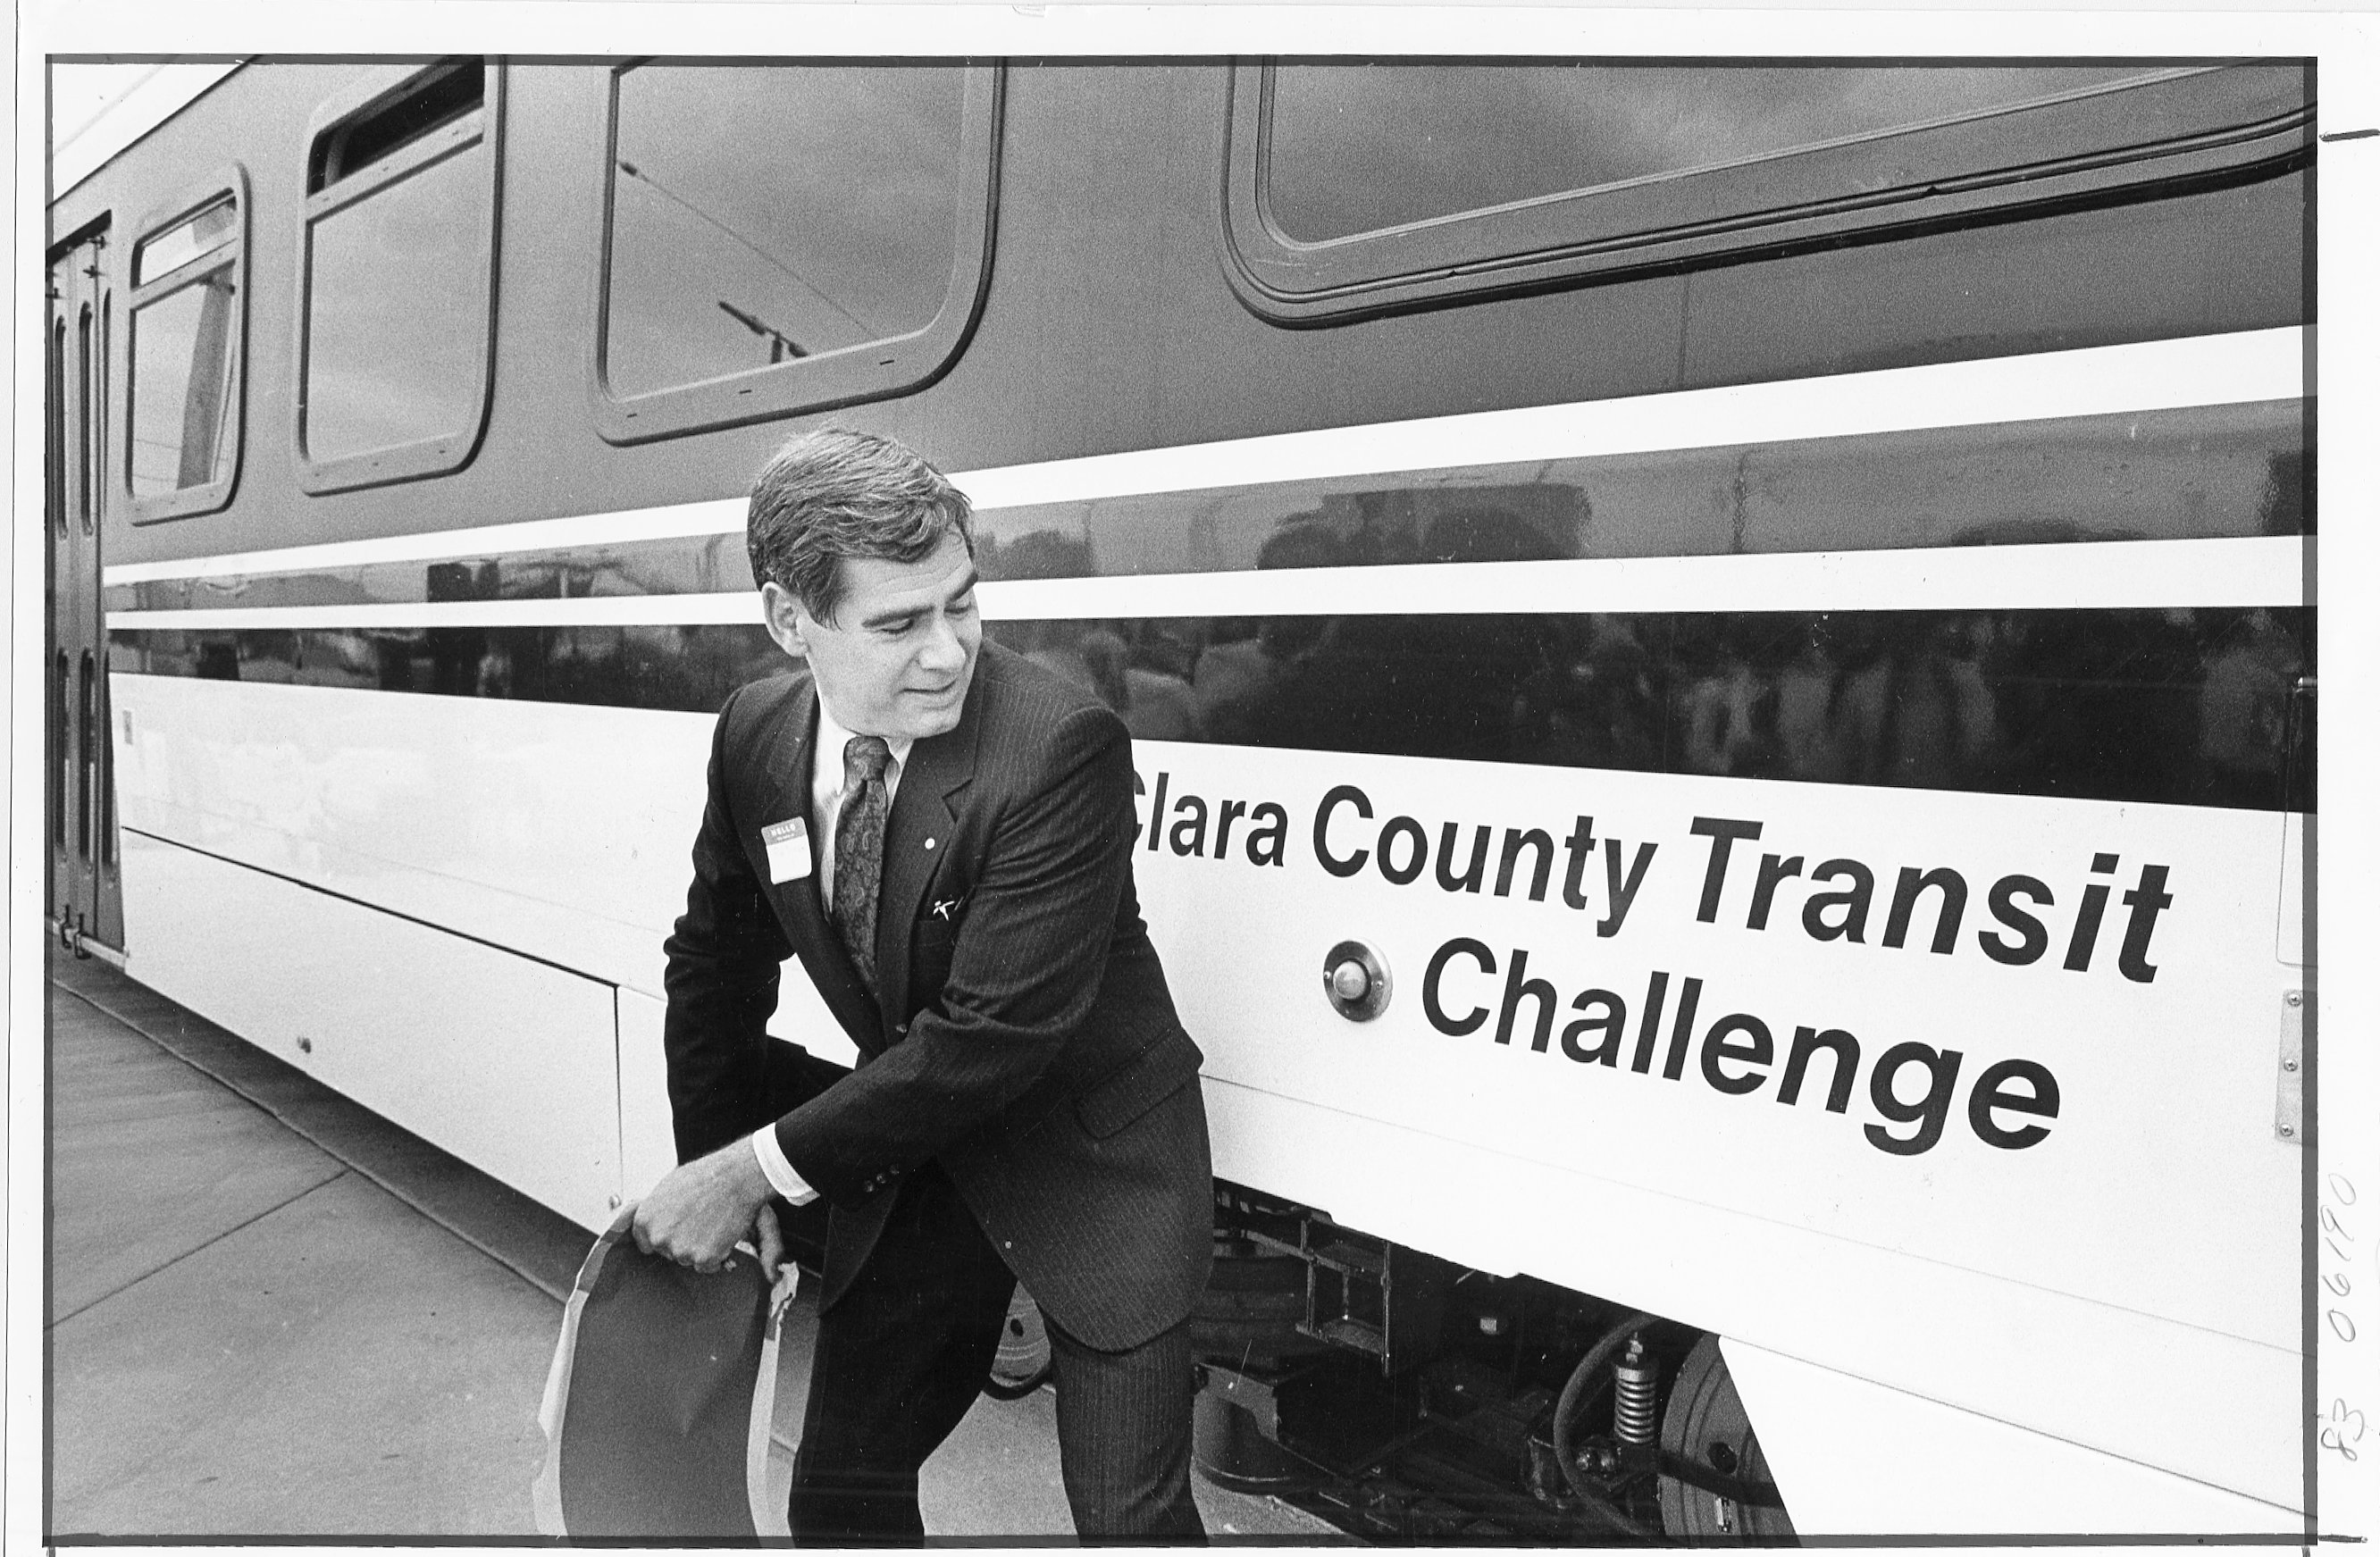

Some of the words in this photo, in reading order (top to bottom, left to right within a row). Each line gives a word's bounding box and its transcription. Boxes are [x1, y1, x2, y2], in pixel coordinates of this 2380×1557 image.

[770, 823, 796, 837] HELLO
[1313, 785, 1658, 937] County
[1690, 816, 2173, 983] Transit
[1423, 938, 2059, 1155] Challenge
[2320, 1173, 2357, 1343] 06190
[2320, 1398, 2365, 1461] 83
